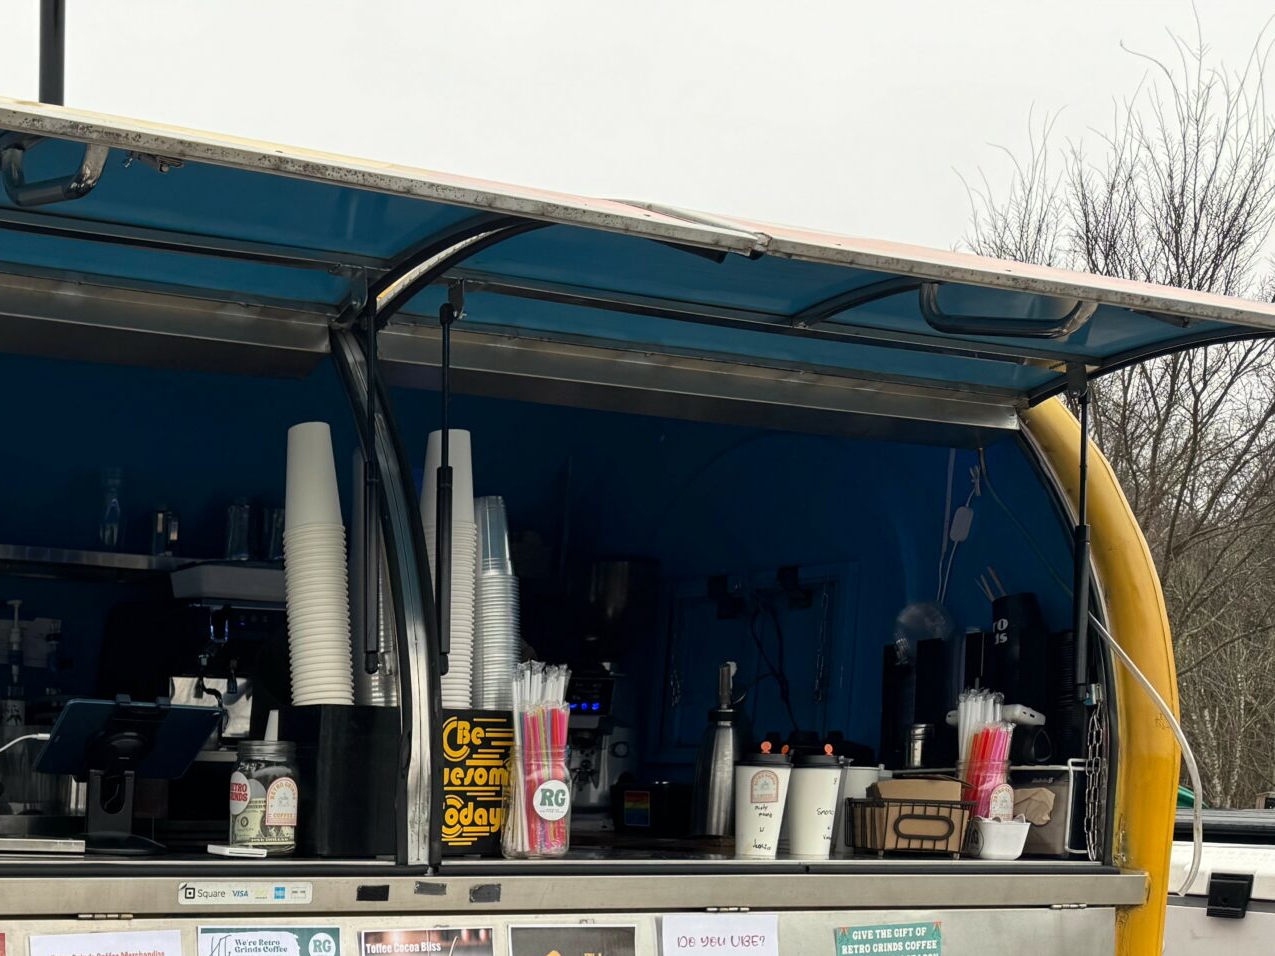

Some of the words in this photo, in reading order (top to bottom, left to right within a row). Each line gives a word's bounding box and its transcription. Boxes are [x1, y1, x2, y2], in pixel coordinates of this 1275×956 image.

[540, 788, 565, 807] RG
[197, 889, 226, 899] Square
[852, 930, 873, 940] GIVE
[875, 929, 893, 939] THE
[895, 928, 915, 938] GIFT
[915, 927, 927, 937] OF
[235, 938, 254, 946] We're
[312, 939, 332, 952] RG
[366, 943, 392, 954] Toffee
[393, 942, 420, 953] Cocoa
[420, 941, 442, 952] Bliss
[677, 935, 696, 948] DO
[701, 936, 726, 947] YOU
[731, 935, 765, 947] UBE?
[841, 944, 871, 955] RETRO
[872, 942, 904, 954] GRINDS
[905, 940, 937, 951] COFFEE
[263, 945, 288, 953] Coffee
